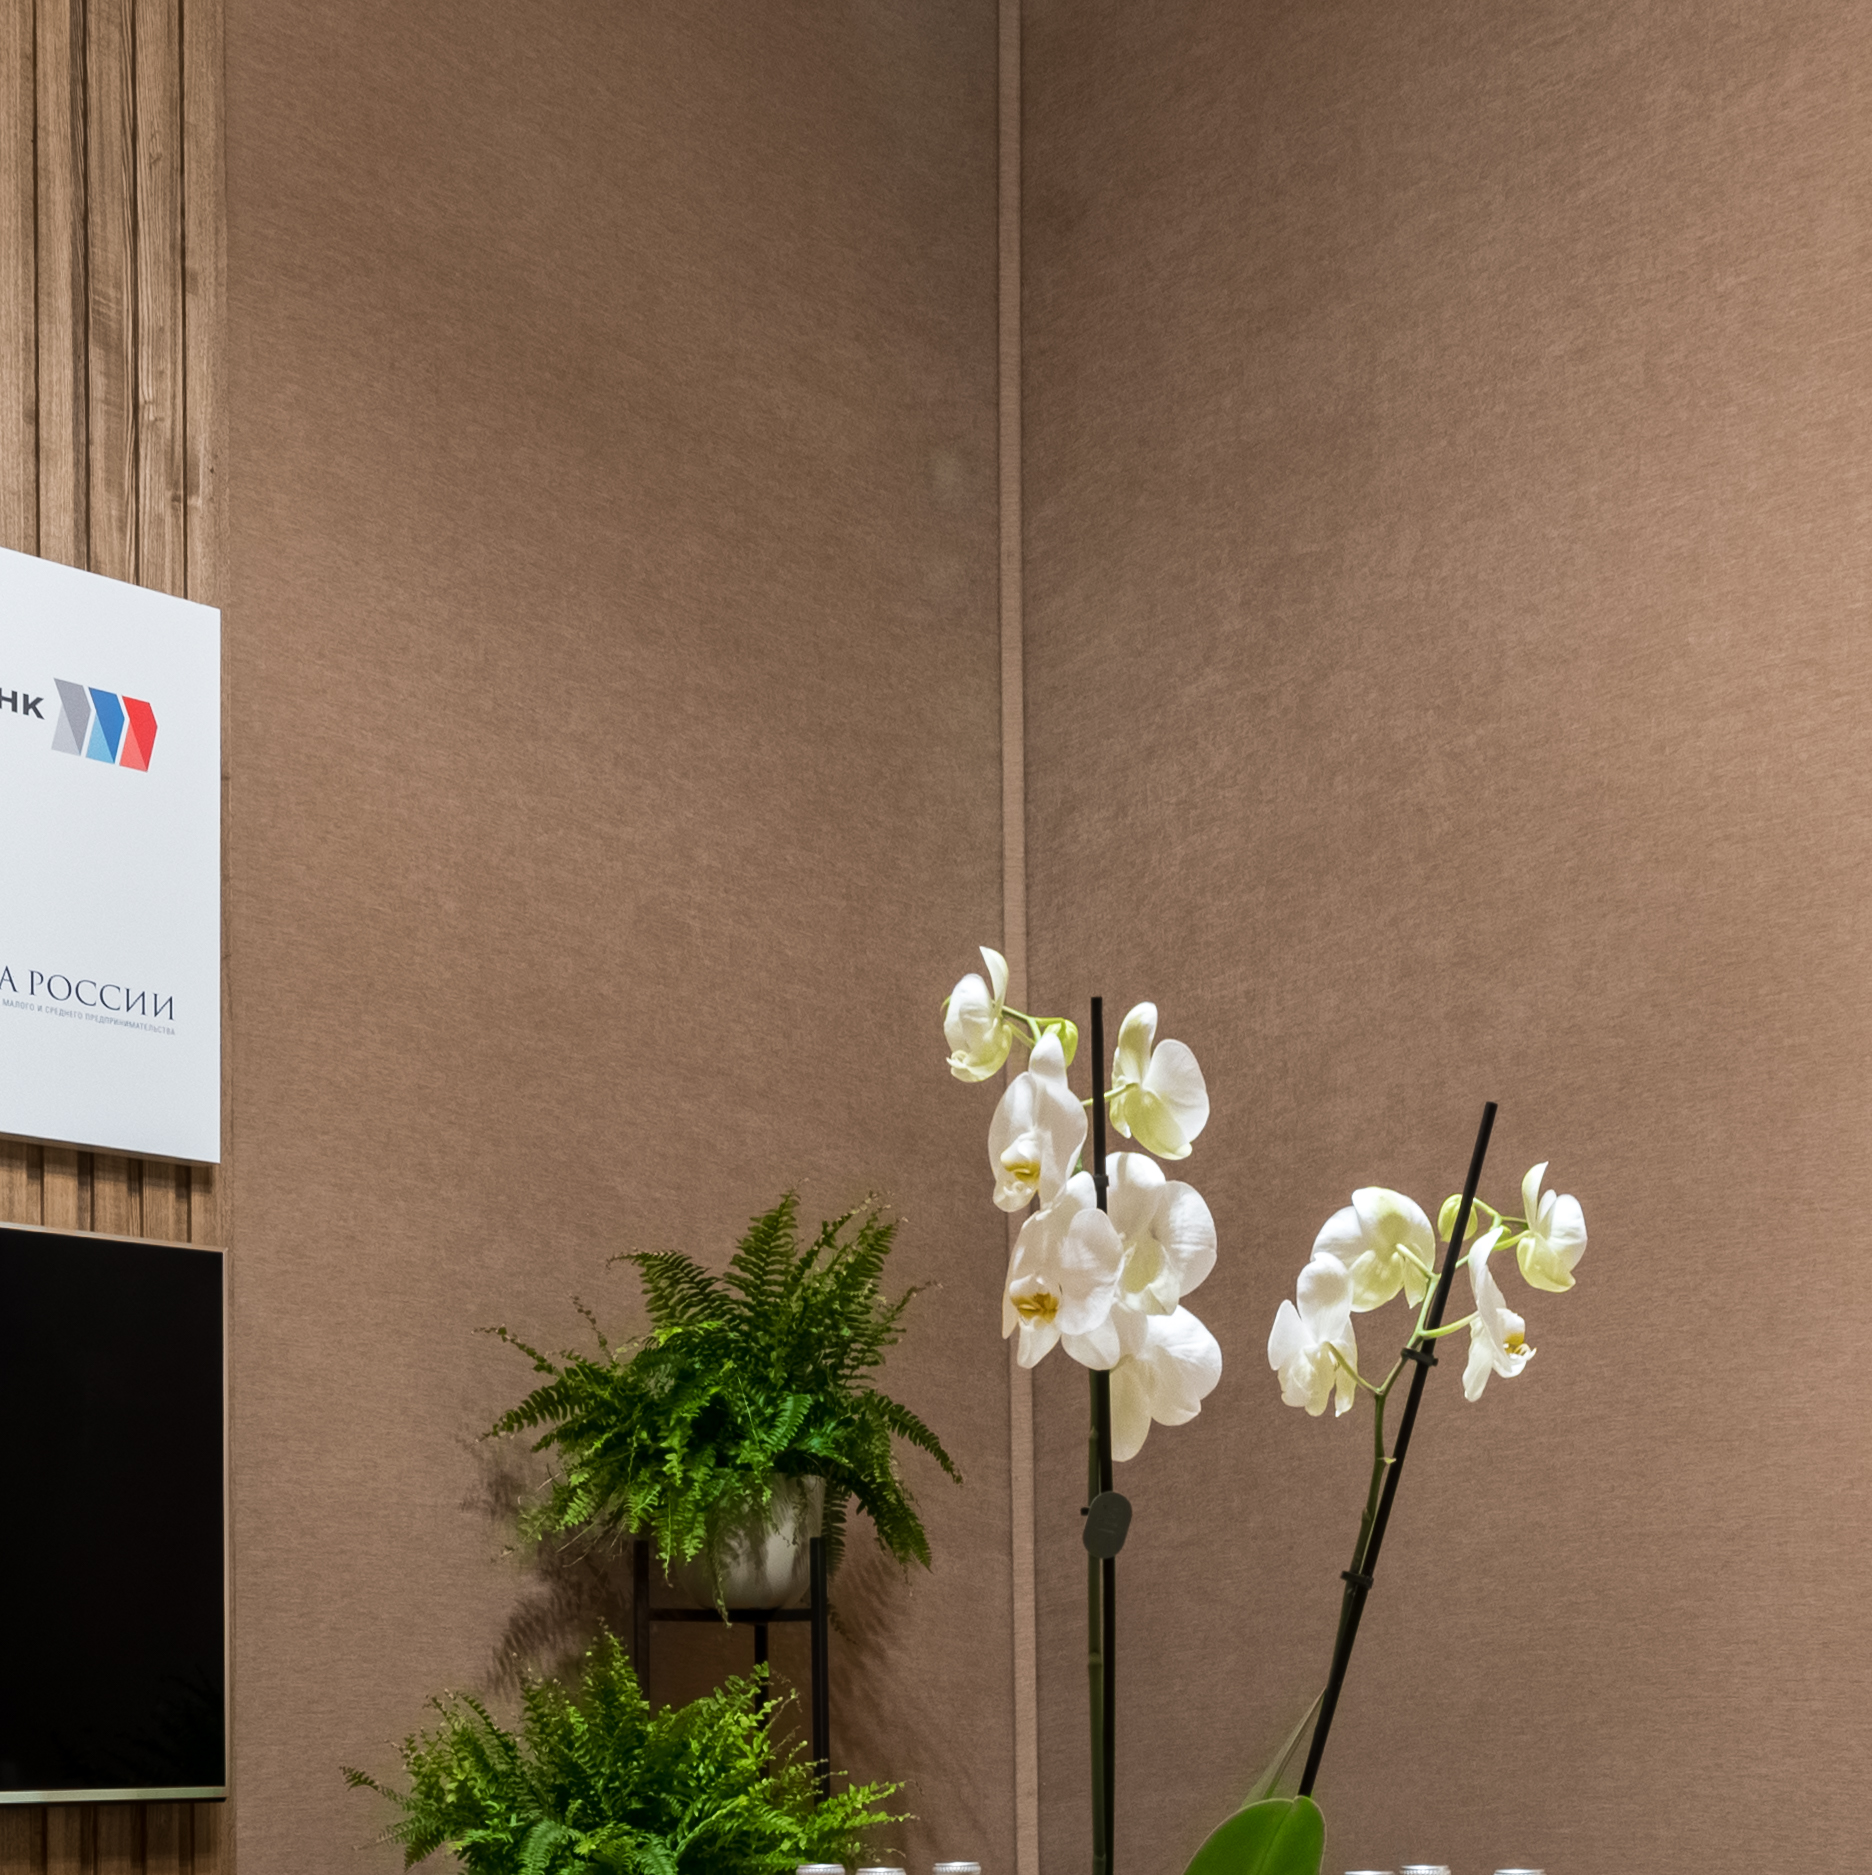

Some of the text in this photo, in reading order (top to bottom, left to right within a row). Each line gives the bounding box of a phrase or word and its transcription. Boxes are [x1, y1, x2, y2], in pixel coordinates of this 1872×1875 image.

[2, 998, 35, 1012] МАЛОГО
[37, 1005, 43, 1013] И
[45, 1005, 83, 1020] СРЕДНЕГО
[85, 1013, 176, 1036] ПРЕДПРИНИМАТЕЛЬСТВА
[29, 970, 176, 1021] РОССИИ
